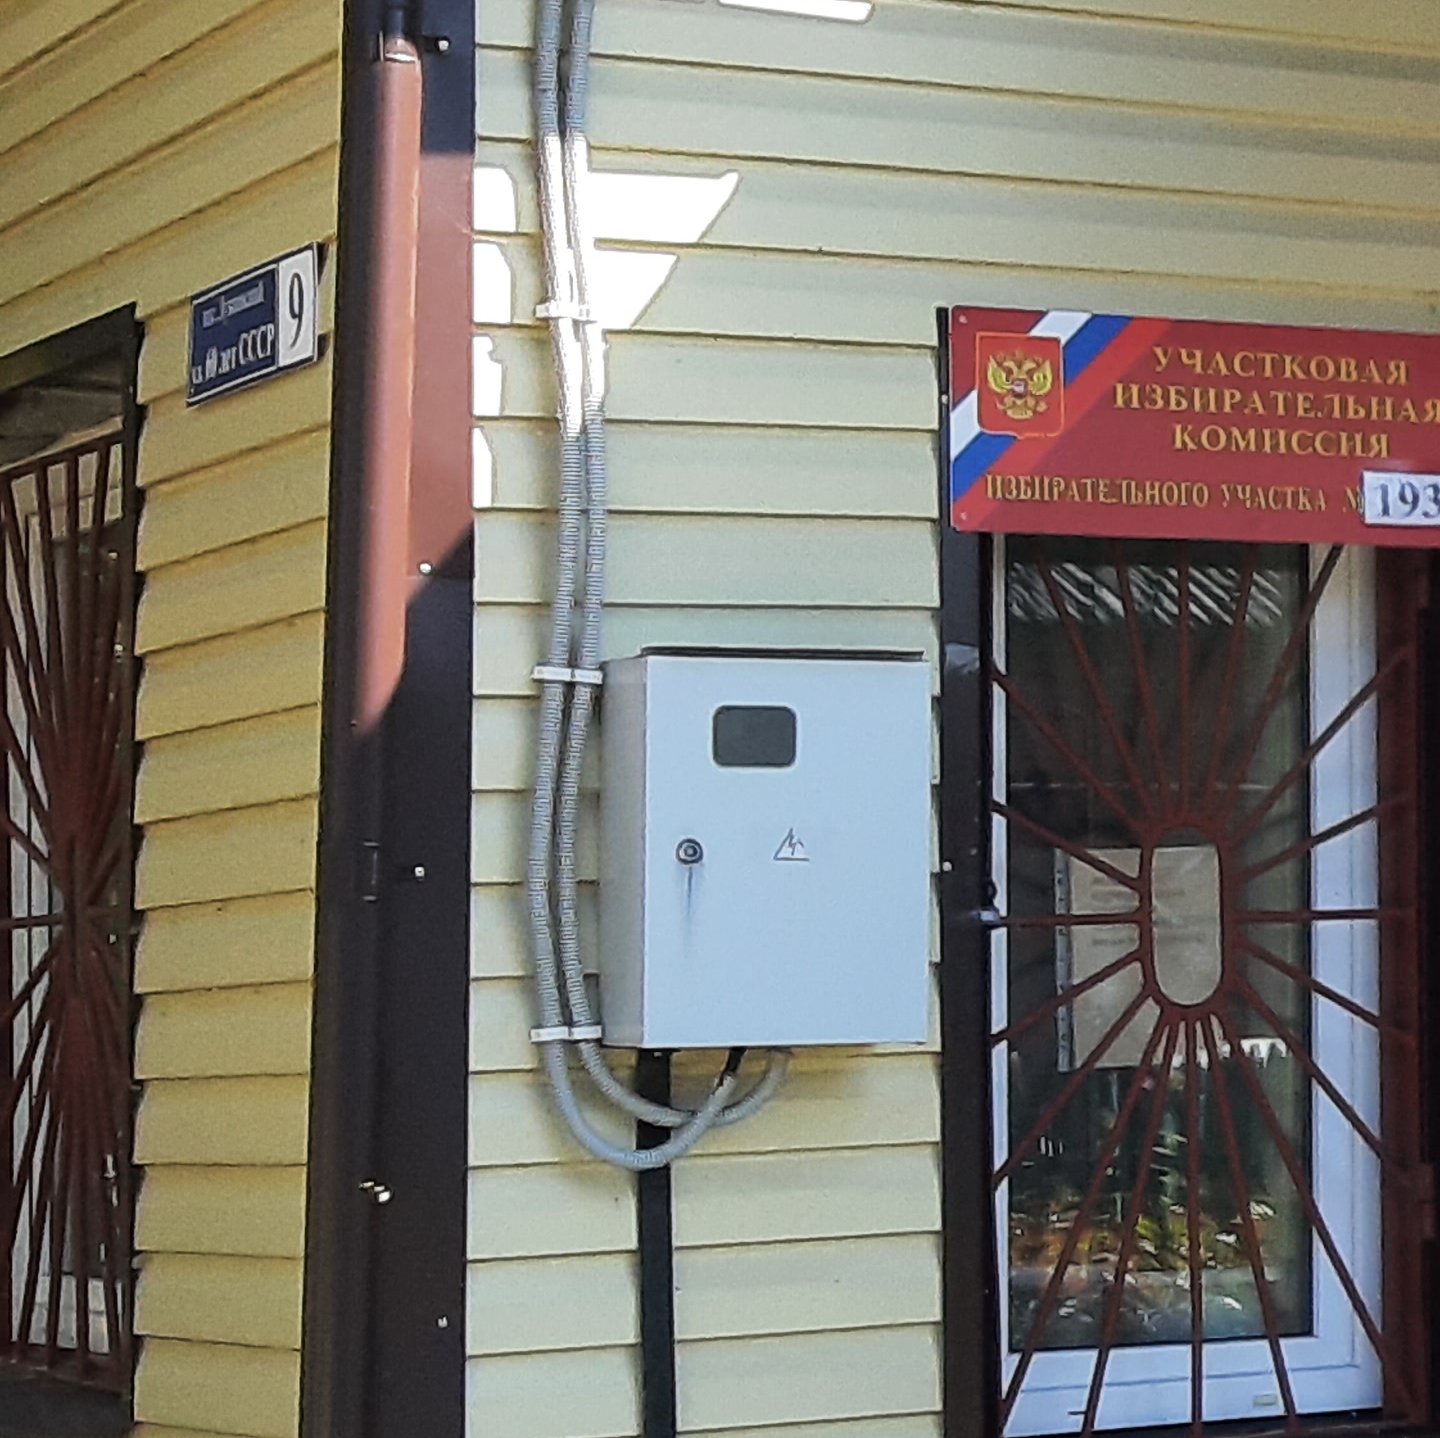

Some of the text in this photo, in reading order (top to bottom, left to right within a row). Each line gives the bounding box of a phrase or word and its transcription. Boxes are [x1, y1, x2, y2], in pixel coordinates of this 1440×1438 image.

[288, 271, 305, 350] 9
[238, 323, 275, 366] СССР
[1152, 346, 1410, 387] УЧАСТКОВАЯ
[1172, 422, 1391, 460] КОМИССИЯ
[984, 472, 1210, 508] ИЗБИРАТЕЛЬНОГО
[1221, 482, 1328, 513] УЧАСТКА
